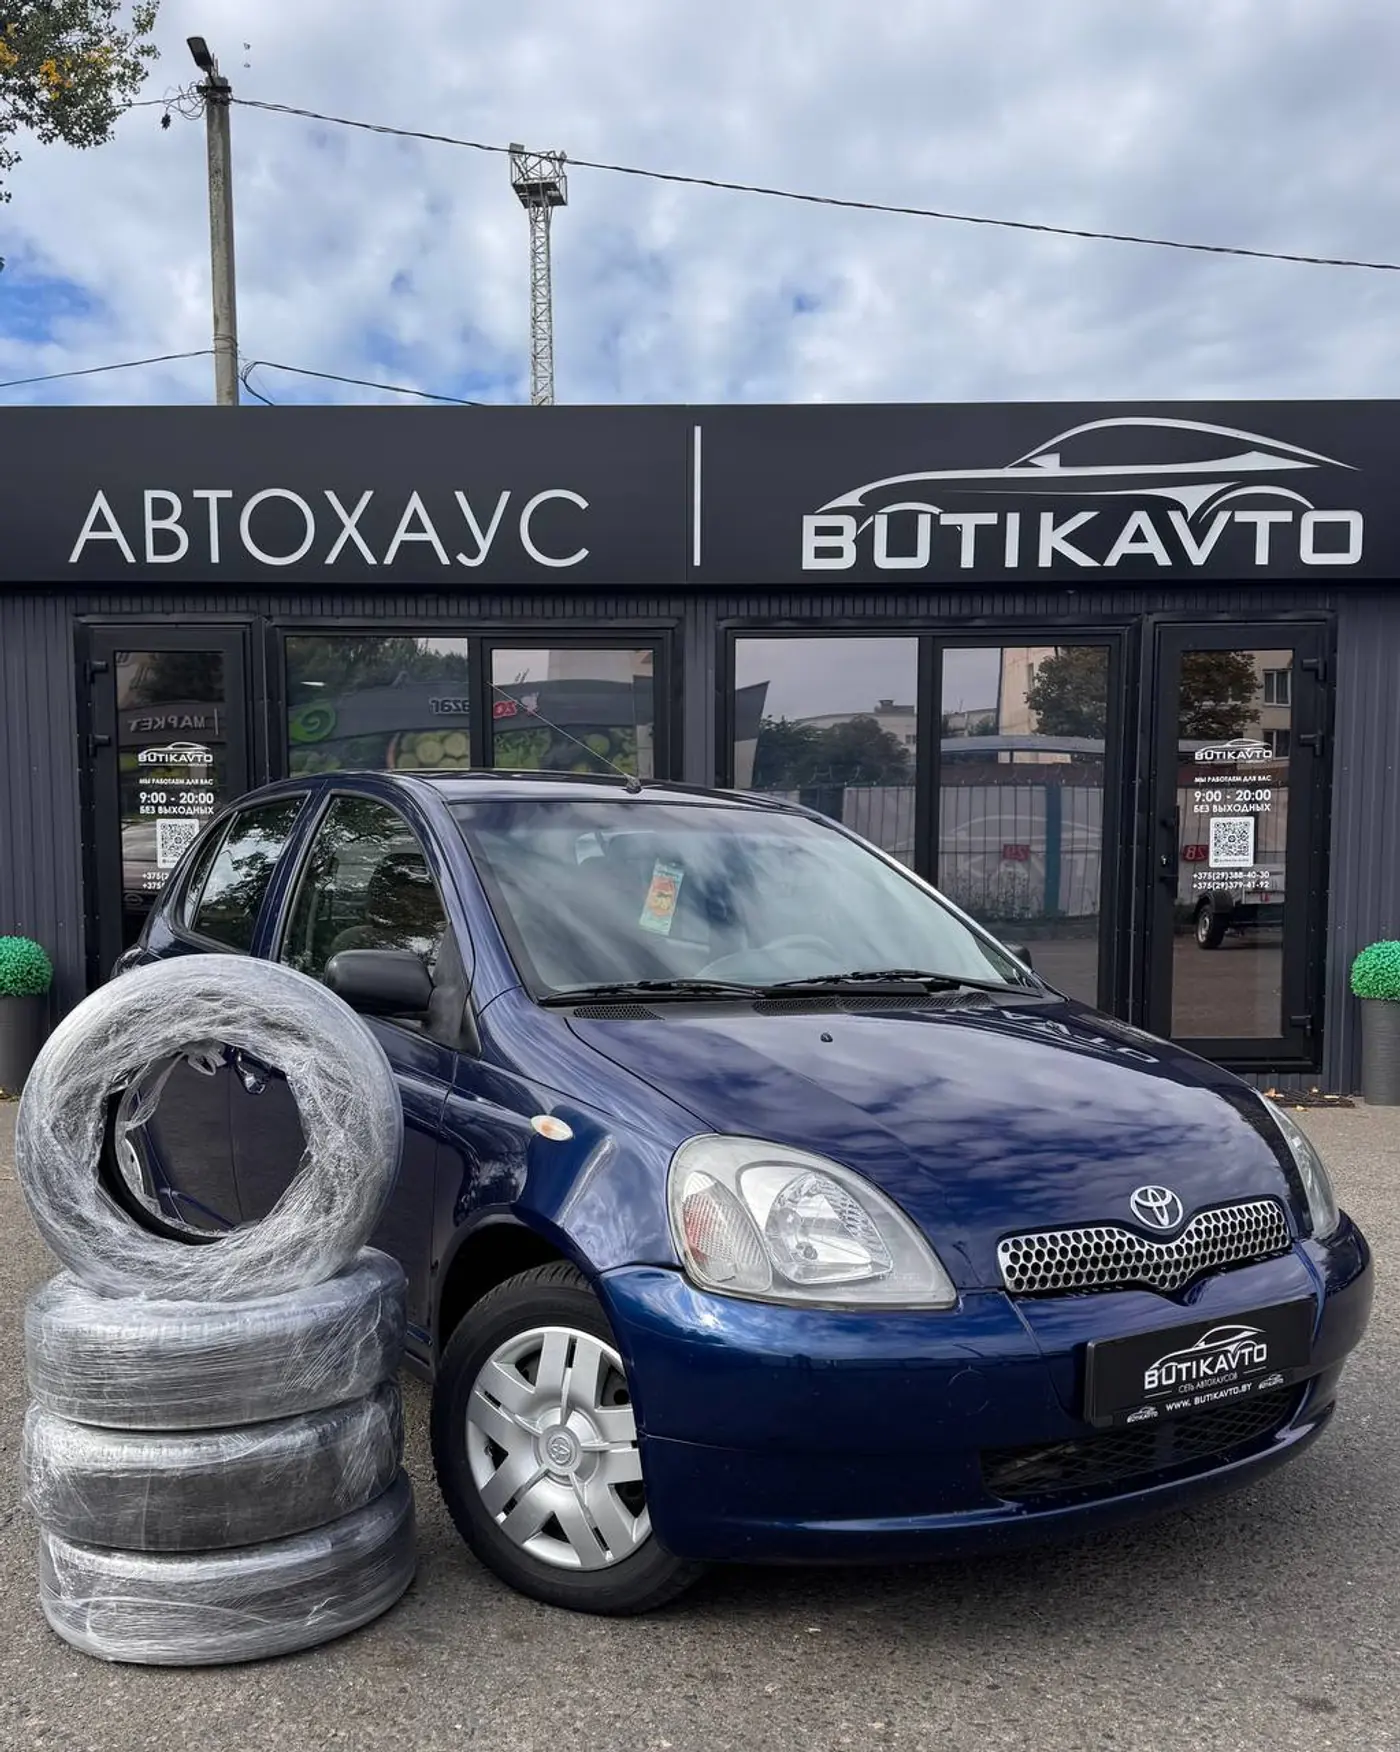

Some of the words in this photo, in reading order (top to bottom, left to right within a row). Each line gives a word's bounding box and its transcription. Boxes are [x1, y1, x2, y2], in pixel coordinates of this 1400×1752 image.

[69, 489, 589, 567] АВТОХАУС
[802, 509, 1363, 570] BUTIKAVTO
[138, 753, 214, 763] BUTIKAVTO
[1195, 750, 1273, 761] BUTIKAVTO
[139, 792, 167, 804] 9:00
[179, 792, 214, 804] 20:00
[1194, 790, 1222, 802] 9:00
[1235, 789, 1272, 801] 20:00
[139, 805, 156, 815] БЕЗ
[157, 805, 214, 815] ВЫХОДНЫХ
[1193, 804, 1210, 813] БЕЗ
[1212, 803, 1271, 813] ВЫХОДНЫХ
[1144, 1343, 1268, 1391] BUTIKAVTO
